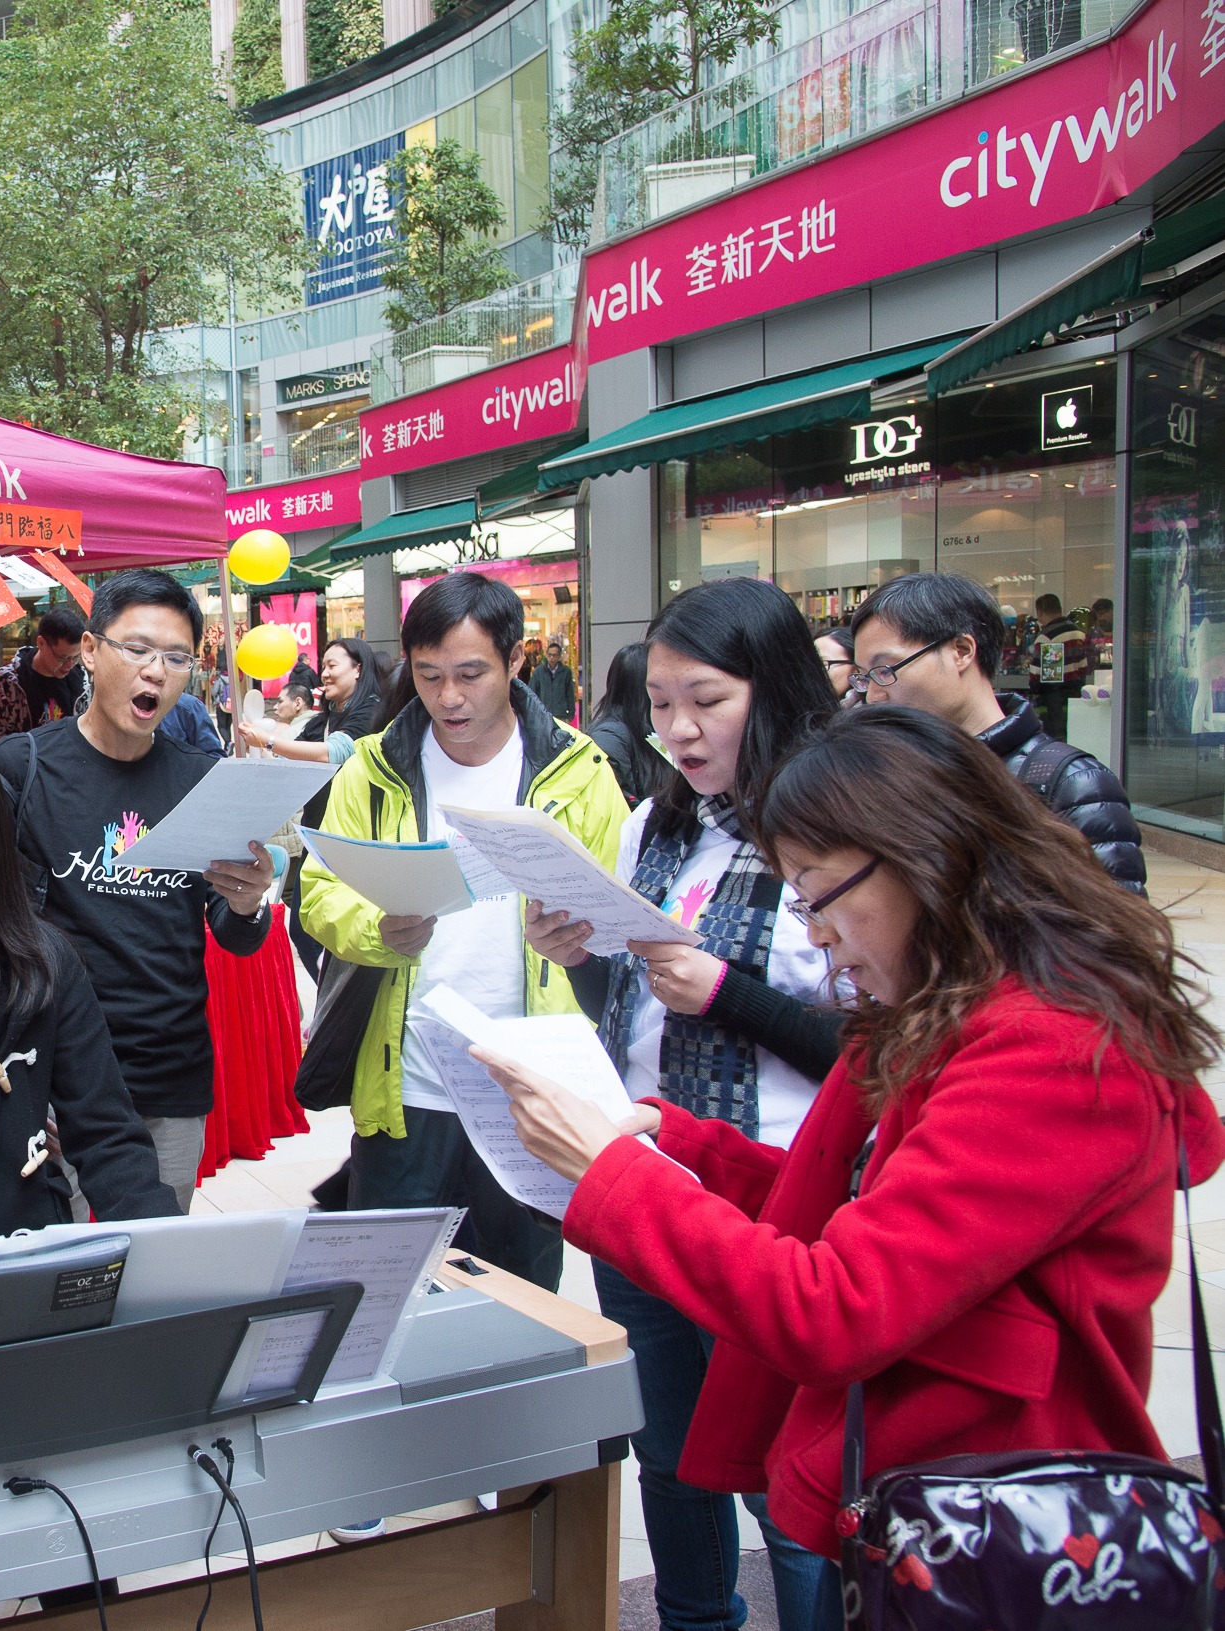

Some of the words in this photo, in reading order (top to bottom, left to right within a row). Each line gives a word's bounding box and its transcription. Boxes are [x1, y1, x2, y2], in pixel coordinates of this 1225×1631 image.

[939, 29, 1177, 208] citywalk
[685, 198, 837, 297] 荃新天地
[317, 275, 355, 294] Japanese
[286, 381, 324, 400] MARKS
[382, 408, 445, 453] 荃新天地
[1046, 435, 1068, 445] Premium
[1068, 432, 1089, 442] Reseller
[282, 489, 334, 519] 荃新天地
[943, 536, 964, 547] G76c
[965, 535, 972, 544] &
[973, 534, 980, 544] d
[52, 846, 193, 889] Hosanna
[88, 883, 168, 899] FELLOWSHIP
[77, 1276, 93, 1287] 20
[104, 1270, 121, 1282] A4
